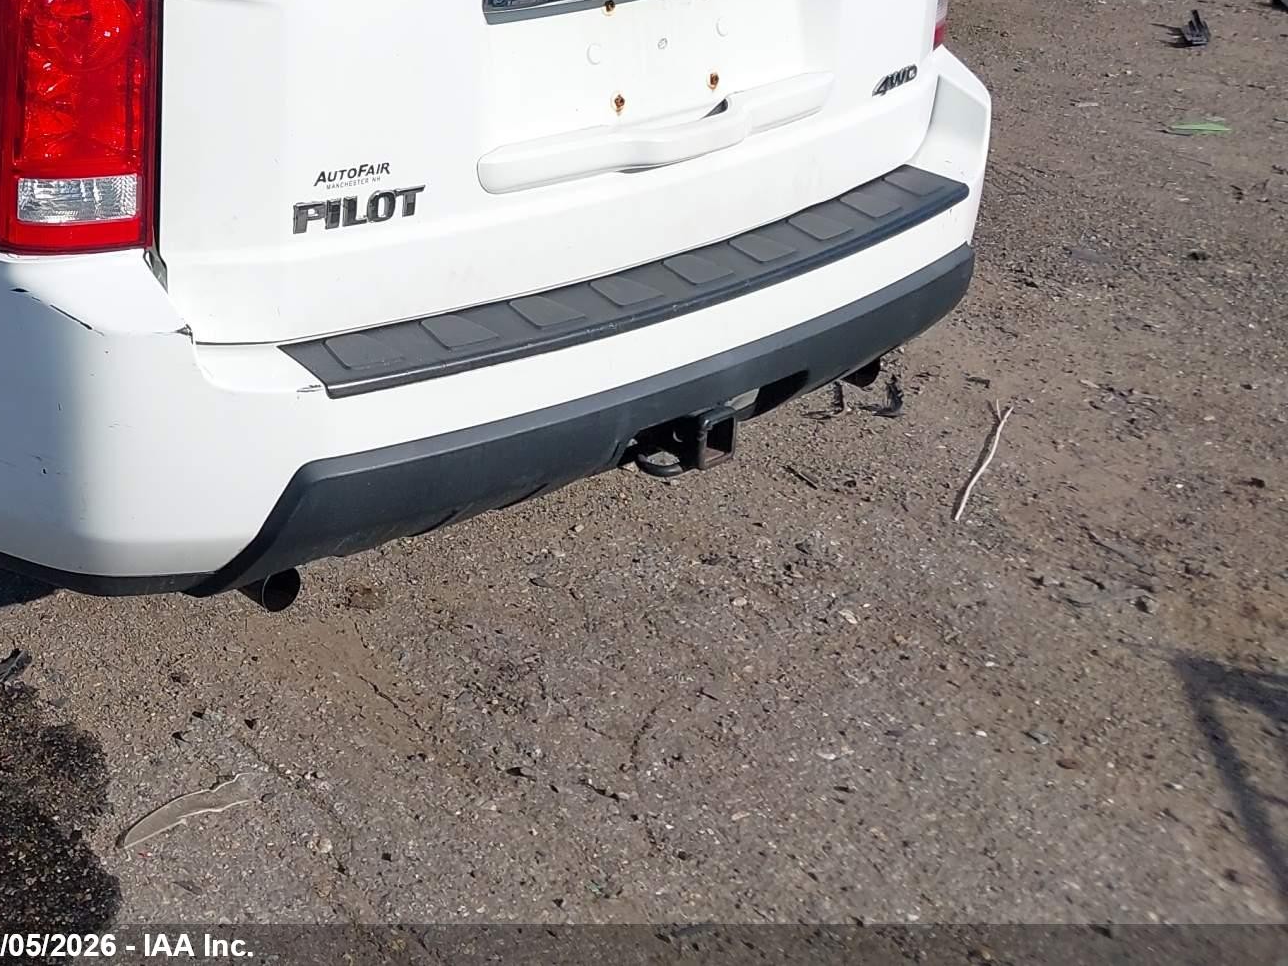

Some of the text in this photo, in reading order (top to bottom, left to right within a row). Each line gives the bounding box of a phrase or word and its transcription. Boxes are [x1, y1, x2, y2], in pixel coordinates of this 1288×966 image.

[871, 63, 918, 97] 4WD
[326, 177, 369, 190] MANCHESTER
[293, 184, 426, 234] PILOT
